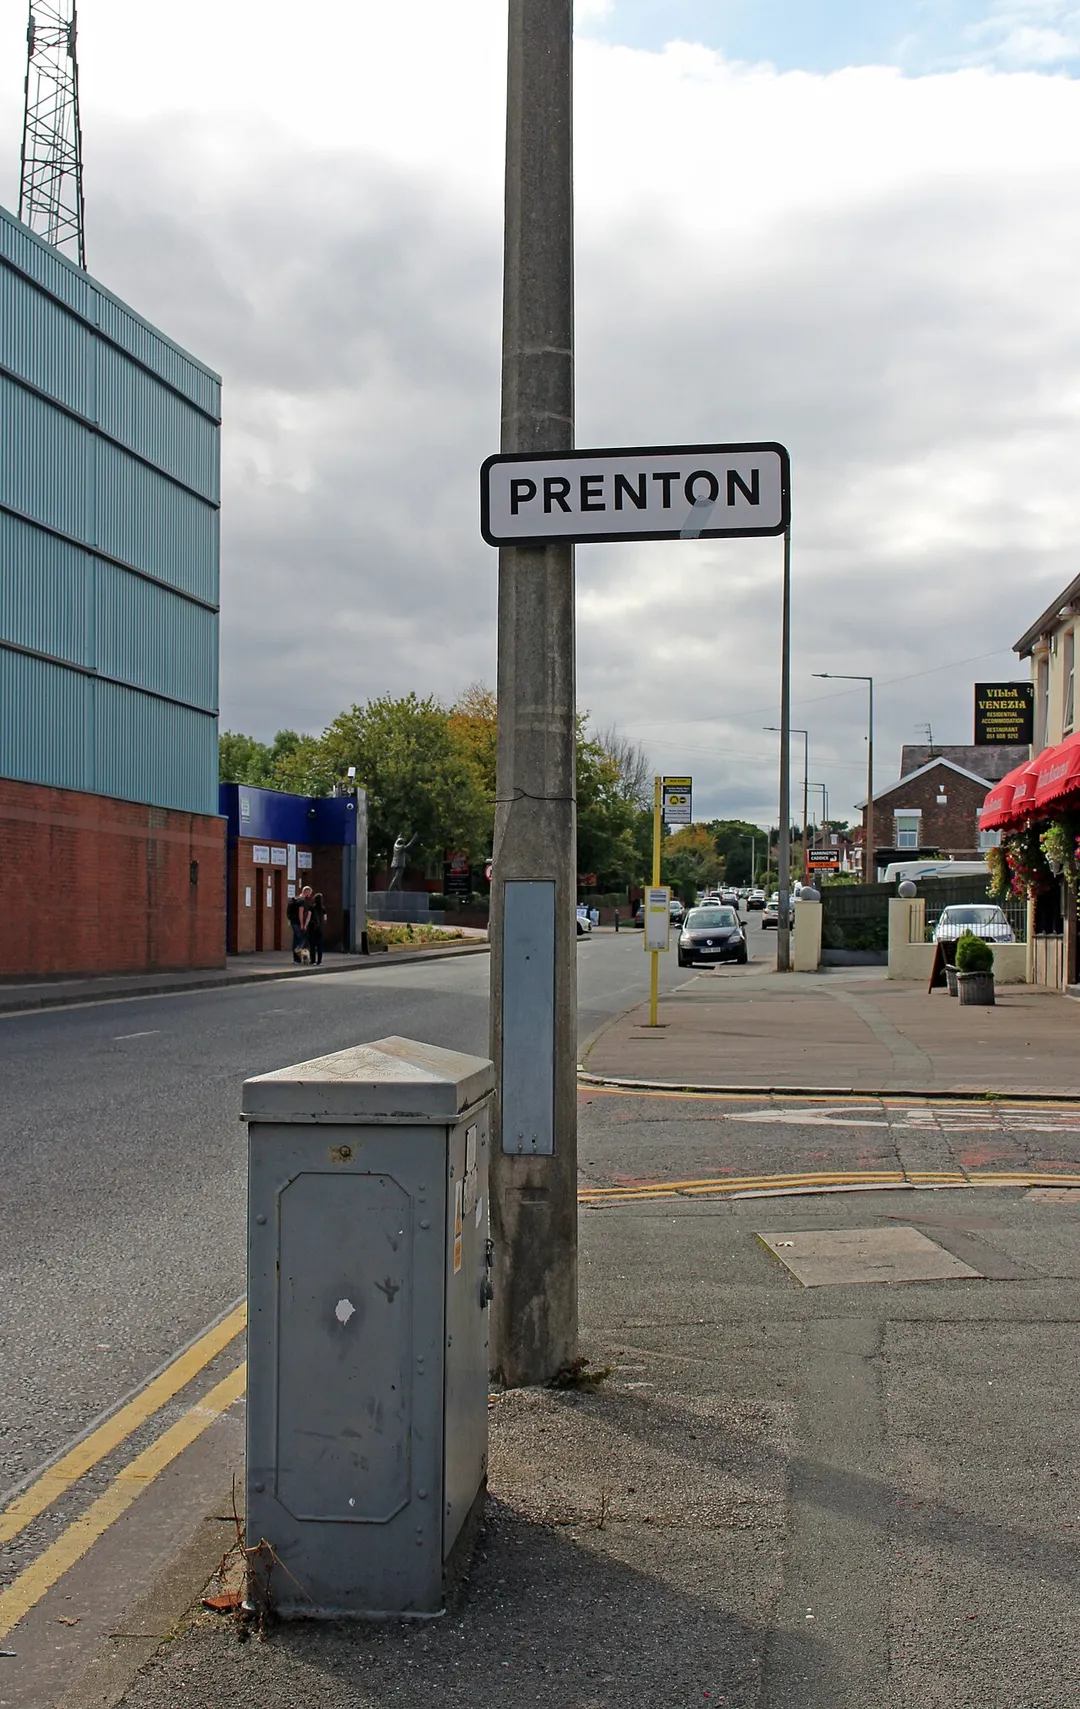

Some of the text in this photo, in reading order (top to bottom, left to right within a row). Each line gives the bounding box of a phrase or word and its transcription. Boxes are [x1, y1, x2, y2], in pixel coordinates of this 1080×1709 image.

[509, 468, 760, 515] PRENTON
[986, 689, 1018, 697] VILLA
[978, 701, 1027, 709] VENEZIA
